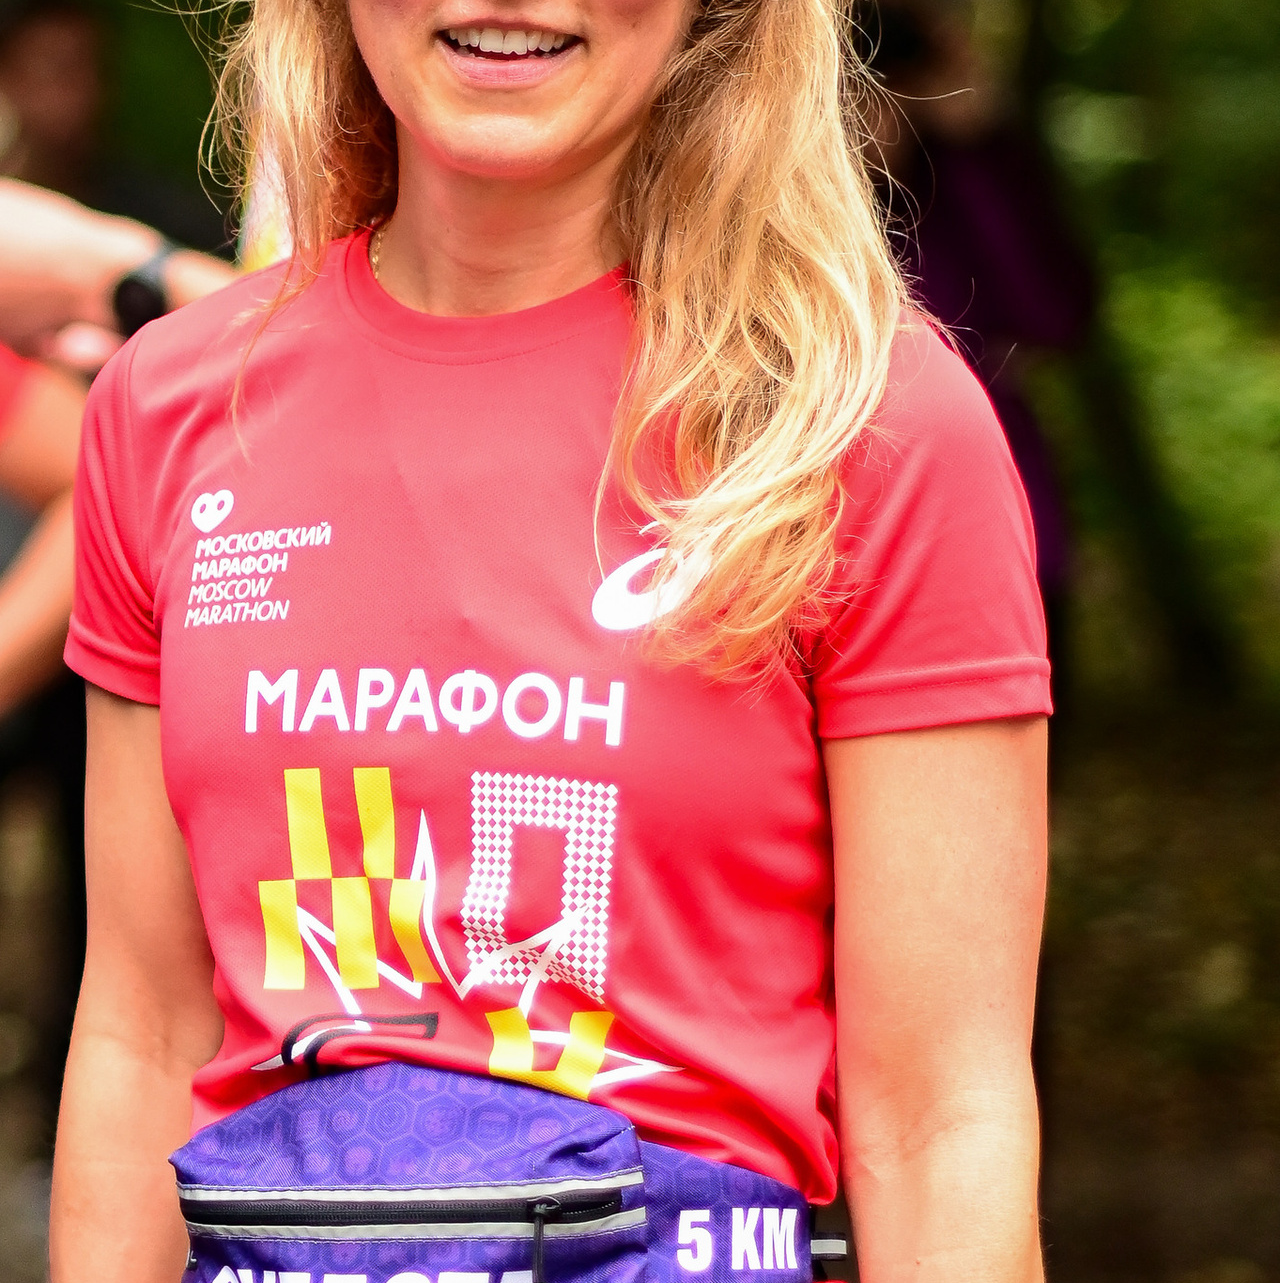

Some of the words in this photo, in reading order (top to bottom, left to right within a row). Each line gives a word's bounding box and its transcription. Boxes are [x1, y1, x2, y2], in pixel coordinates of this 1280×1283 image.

[195, 521, 331, 558] МОСКОВСКИЙ
[191, 552, 288, 582] МАРАФОН
[187, 576, 273, 605] MOSCOW
[183, 599, 290, 628] MARATHON
[244, 668, 625, 747] МАРАФОН
[676, 1209, 712, 1272] 5
